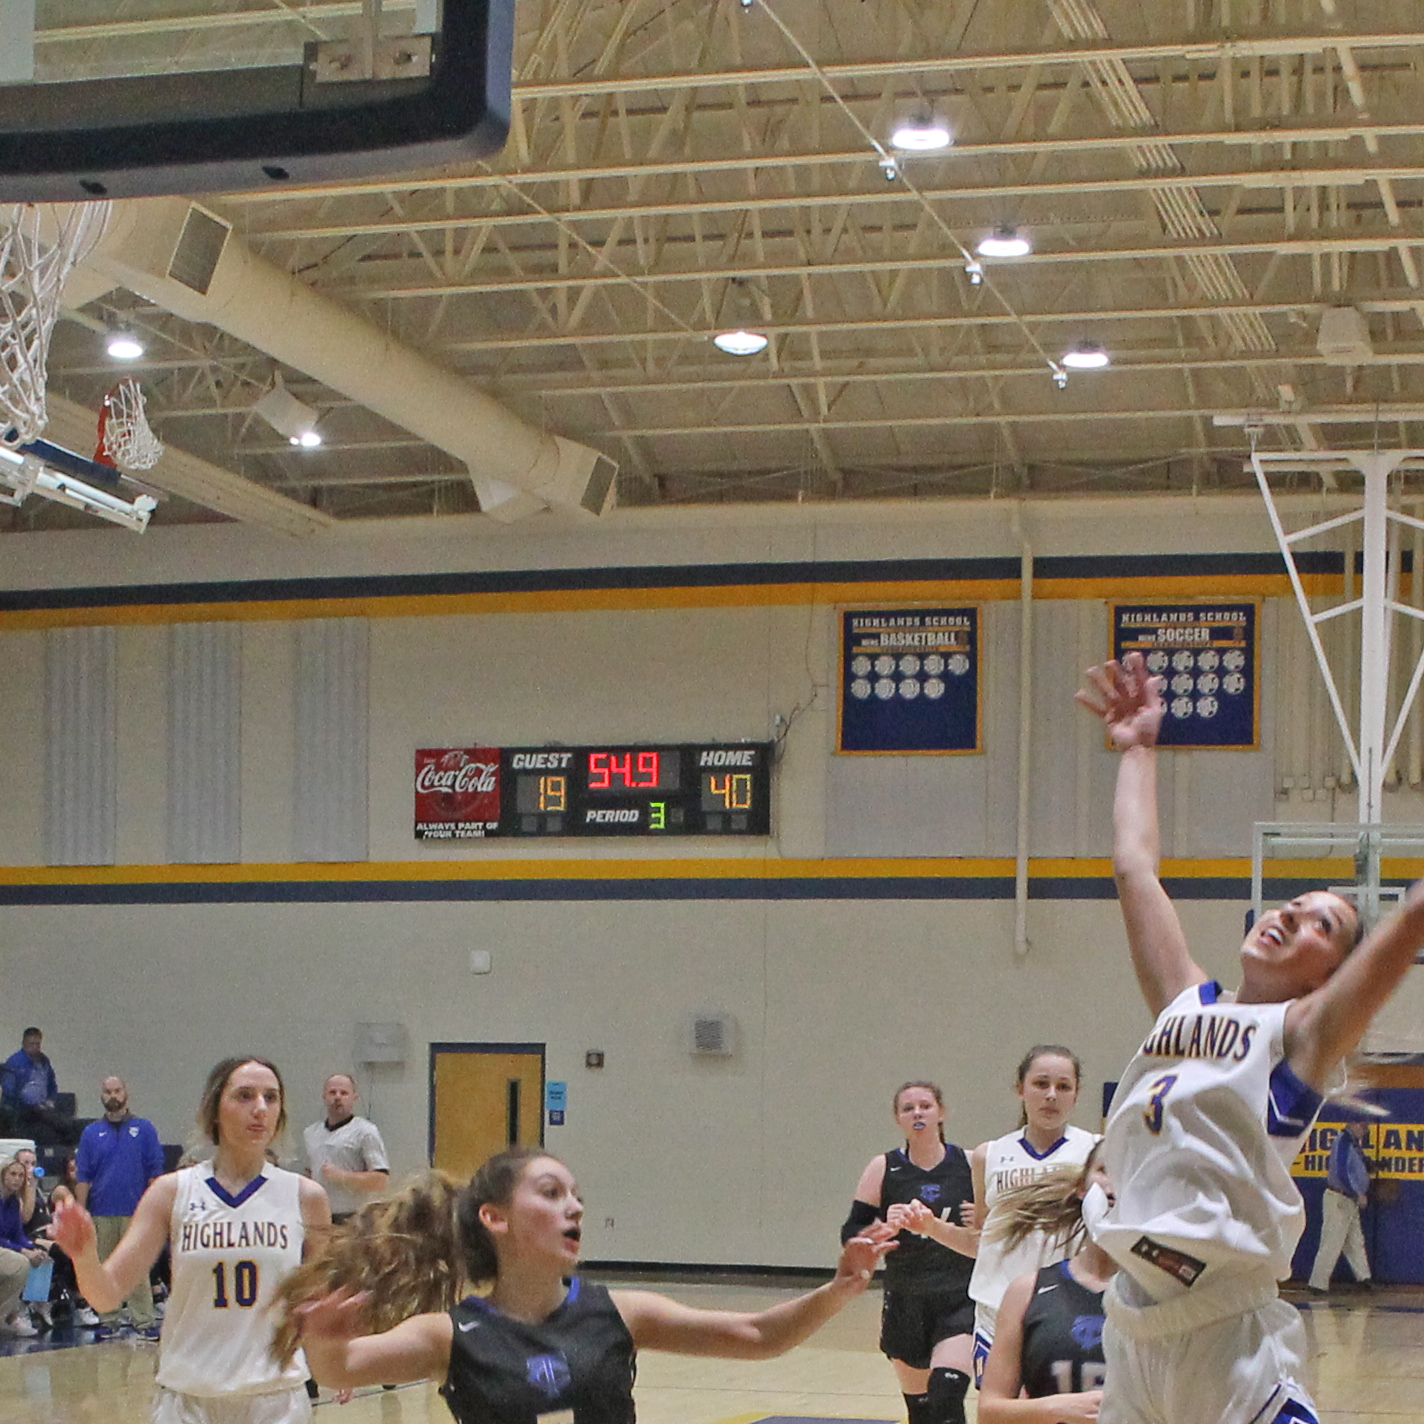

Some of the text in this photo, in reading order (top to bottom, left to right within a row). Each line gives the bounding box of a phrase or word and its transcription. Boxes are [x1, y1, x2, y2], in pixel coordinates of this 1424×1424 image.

[852, 616, 970, 628] HIGHLANDS SCHOOL
[1121, 611, 1246, 623] HIGHLANDS SCHOOL
[880, 632, 956, 646] BASKETBALL
[1157, 628, 1210, 641] SOCCER
[512, 753, 572, 769] GUEST
[700, 750, 755, 766] HOME
[539, 776, 566, 811] 19
[710, 774, 752, 809] 40
[586, 802, 666, 829] PERIOD 3
[417, 822, 498, 831] ALWAYS PART OF
[427, 831, 452, 839] YOUR
[182, 1221, 288, 1252] HIGHLANDS
[212, 1259, 260, 1309] 10
